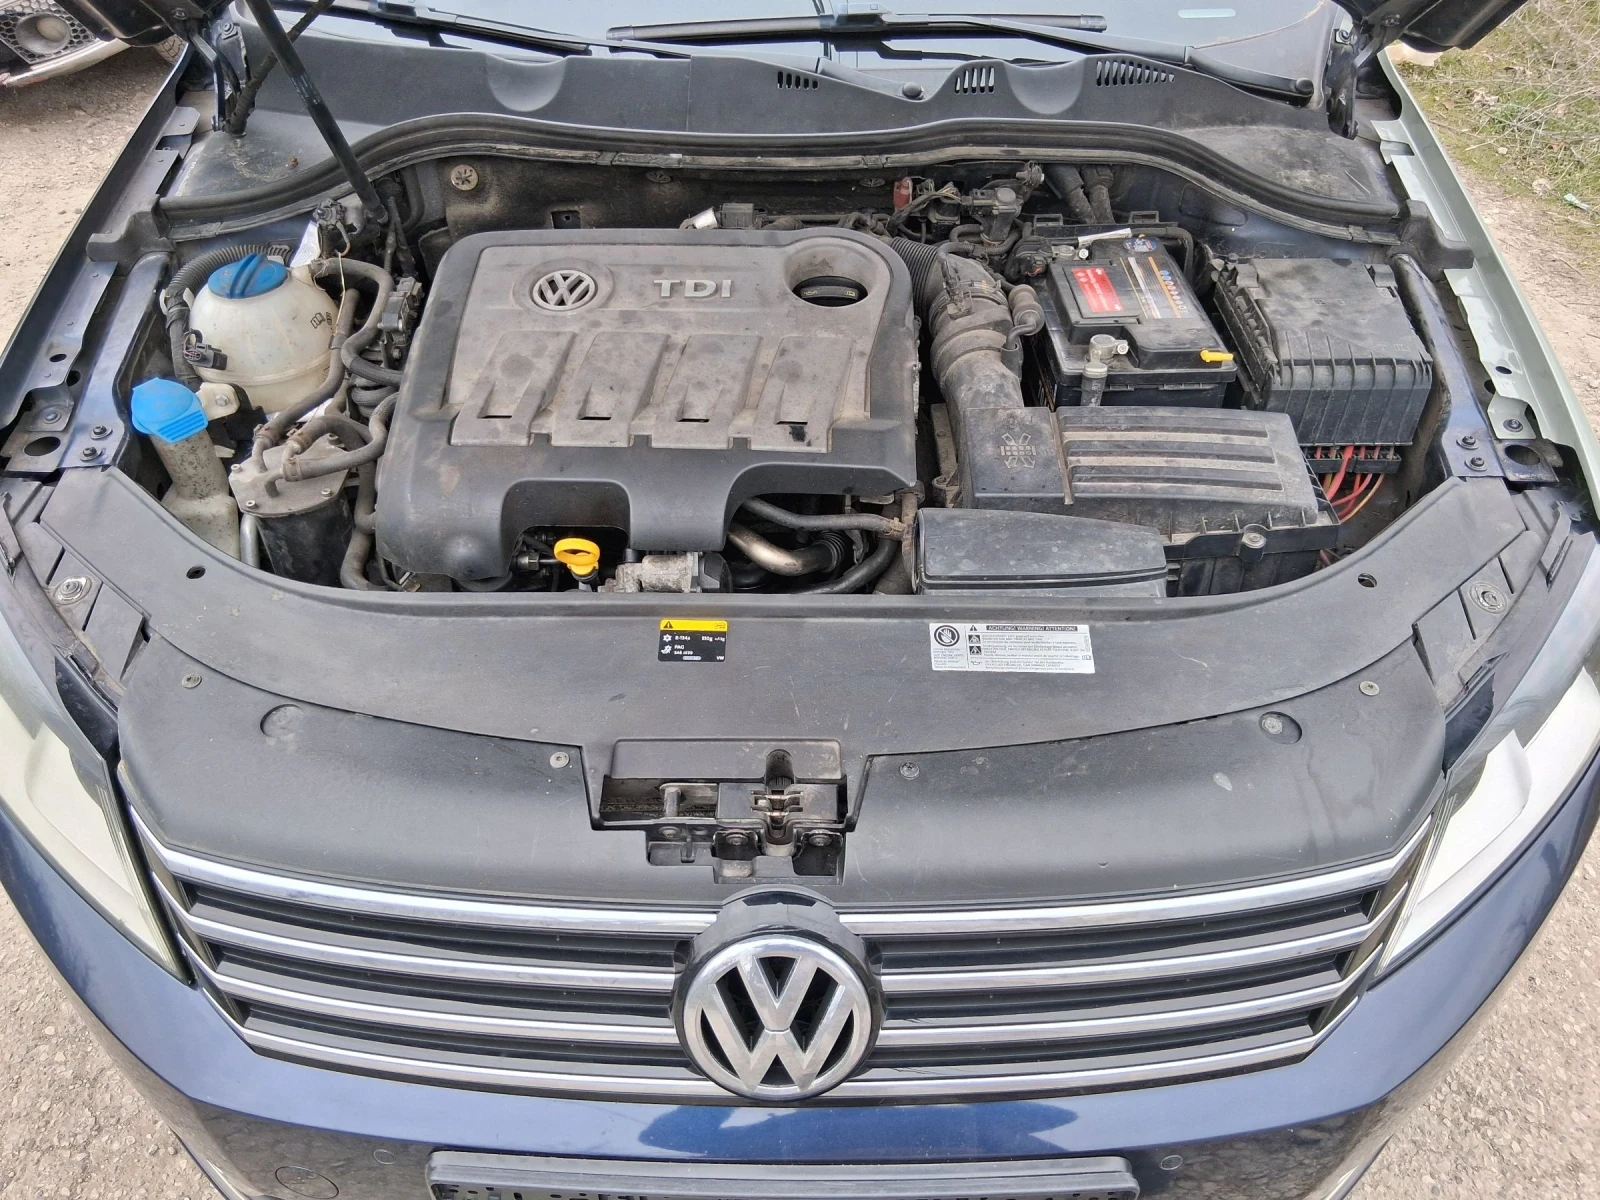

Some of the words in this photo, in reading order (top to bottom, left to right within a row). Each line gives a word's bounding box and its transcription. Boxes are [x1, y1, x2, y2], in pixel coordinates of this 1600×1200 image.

[533, 270, 596, 311] VW
[654, 279, 732, 297] TDI
[688, 940, 868, 1099] VW
